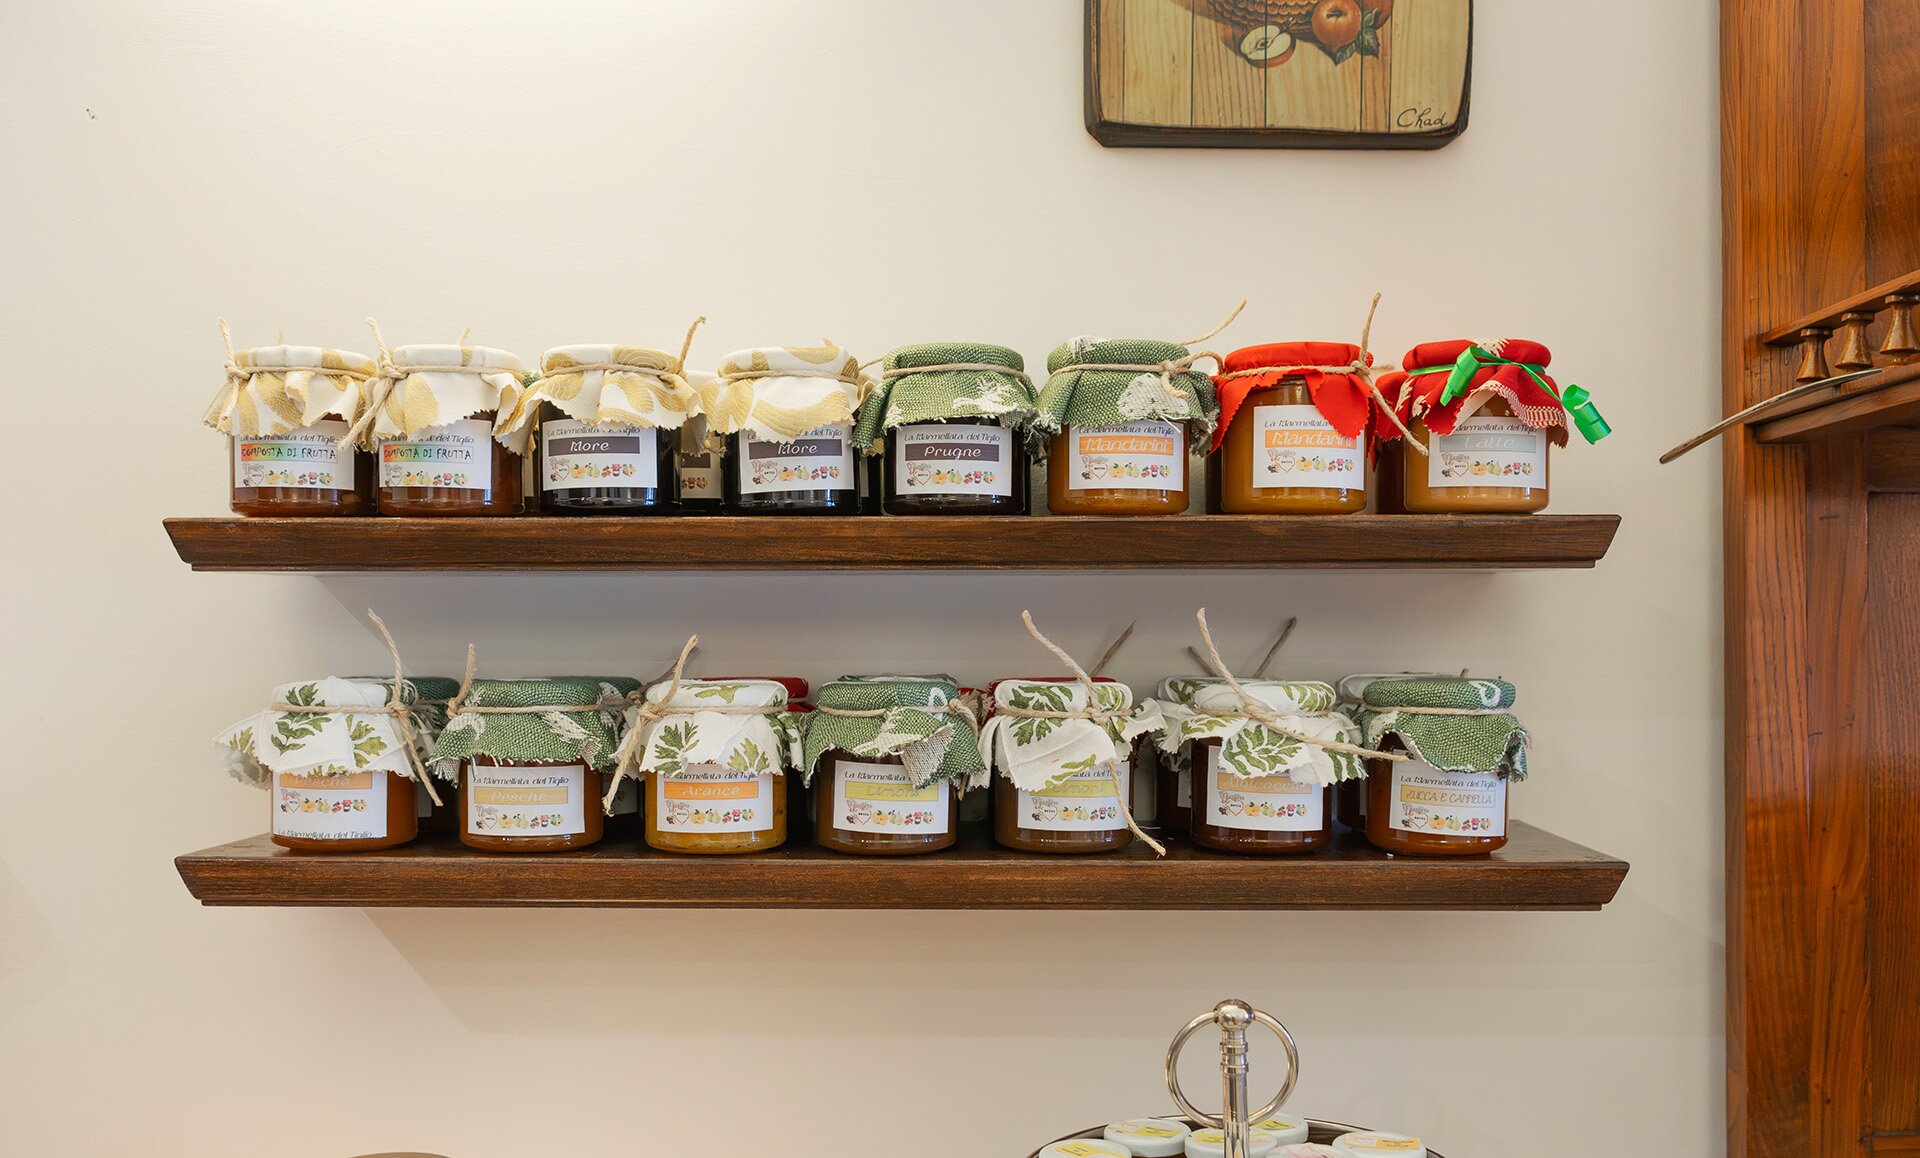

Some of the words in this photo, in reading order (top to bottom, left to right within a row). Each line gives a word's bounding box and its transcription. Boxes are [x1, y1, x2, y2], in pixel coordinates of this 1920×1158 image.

[1397, 107, 1447, 128] Chad
[1278, 420, 1328, 428] Marmellata
[1091, 426, 1141, 434] Marmellata
[1143, 426, 1156, 434] del
[1158, 427, 1175, 437] Tiglio
[917, 433, 963, 441] Marmellata
[966, 433, 980, 441] del
[981, 433, 1001, 443] Tiglio
[1465, 435, 1514, 449] Latte
[570, 441, 610, 452] More
[777, 444, 818, 454] More
[1085, 438, 1168, 453] Mandarini
[241, 447, 283, 458] COMPOSTA
[287, 448, 297, 457] DI
[301, 448, 336, 459] FRUTTA
[384, 448, 420, 458] COMPOSTA
[422, 449, 432, 458] DI
[436, 448, 472, 460] FRUTTA
[924, 446, 981, 459] Prugne
[483, 777, 529, 785] Marmellata
[532, 777, 546, 785] del
[547, 777, 569, 787] Tiglio
[857, 772, 906, 781] Marmellata
[1400, 775, 1411, 783] La
[1414, 776, 1464, 788] Marmellata
[1466, 779, 1479, 788] del
[491, 791, 549, 803] Pesche
[682, 785, 741, 797] Arance
[1406, 789, 1437, 802] ZUCCA
[1440, 792, 1447, 803] E
